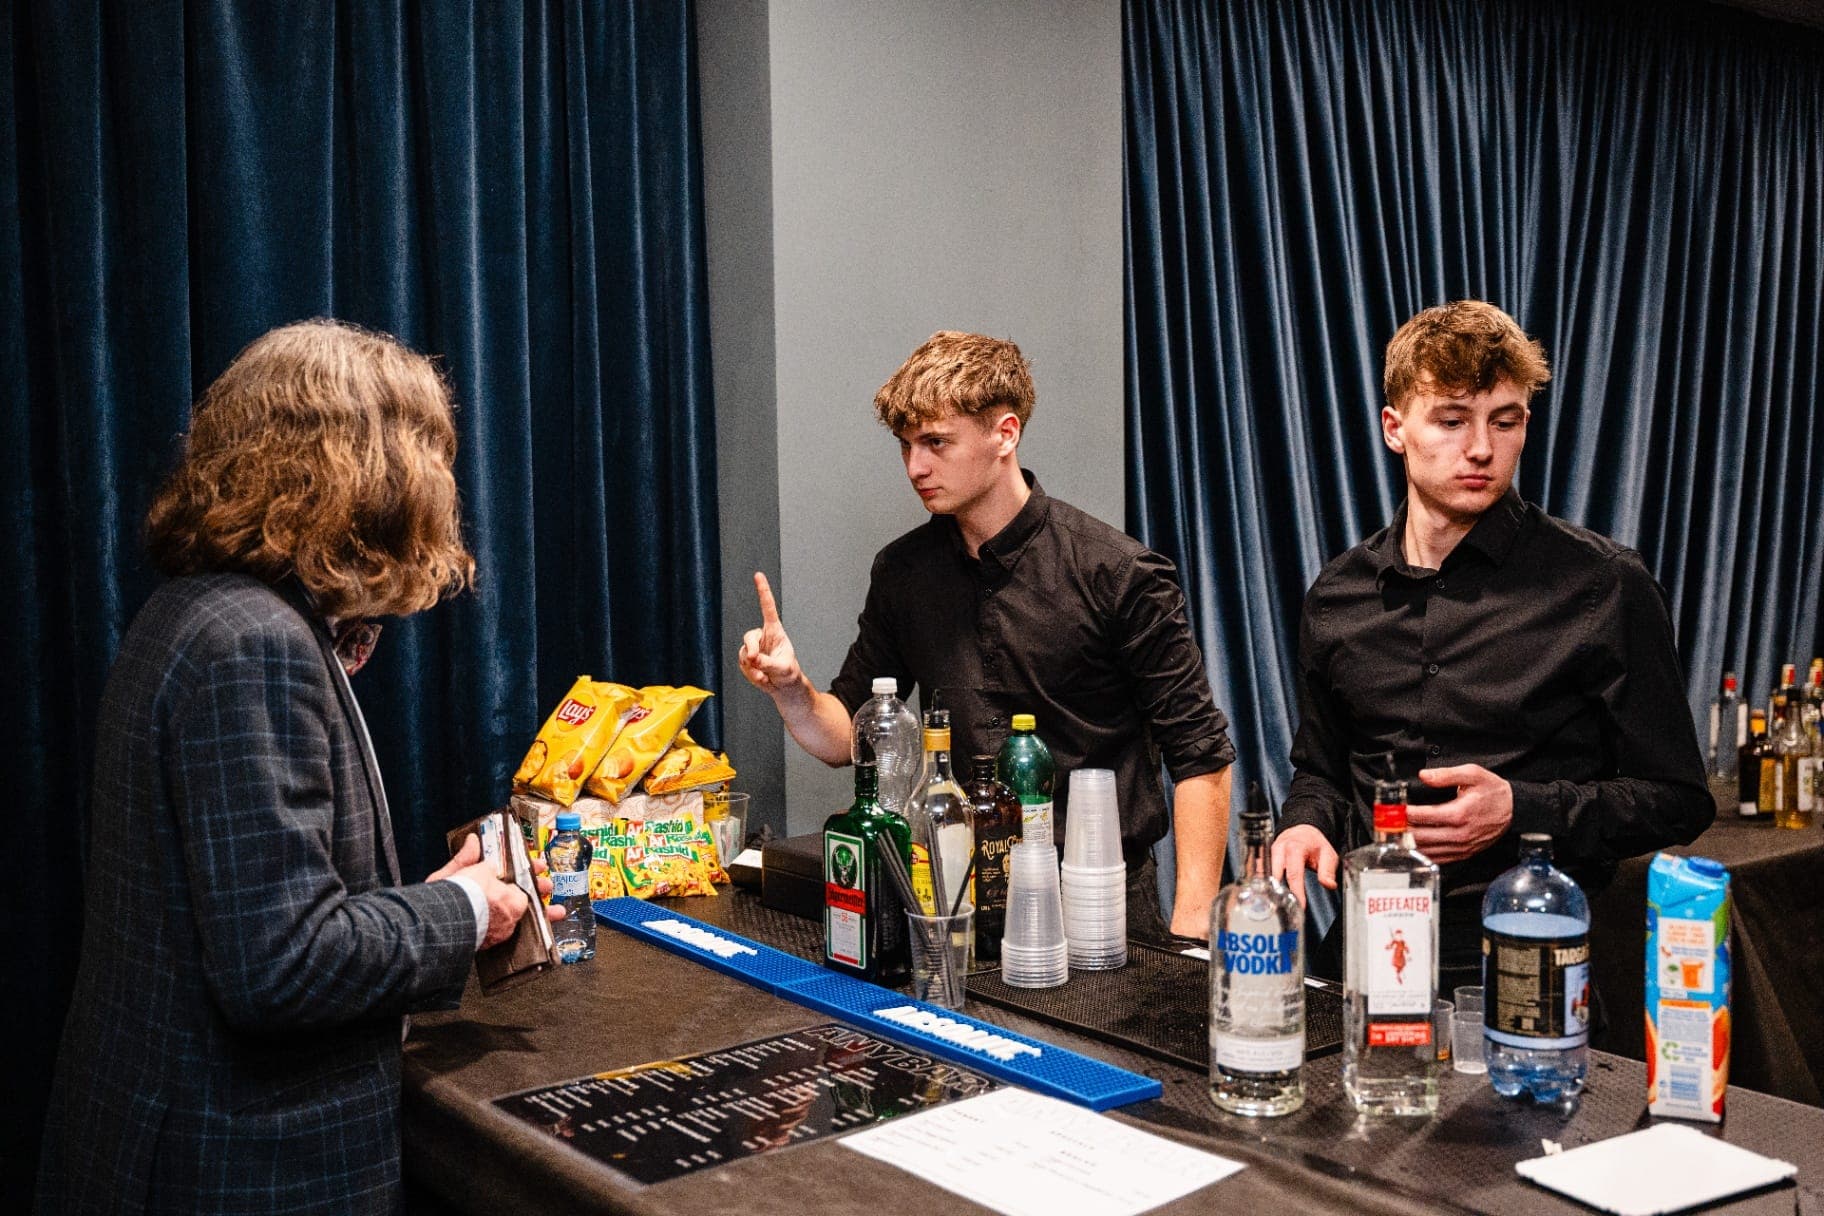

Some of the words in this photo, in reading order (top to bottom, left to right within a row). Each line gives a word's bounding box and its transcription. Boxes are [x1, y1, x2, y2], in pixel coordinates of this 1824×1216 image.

[600, 834, 636, 848] Rashi
[1368, 896, 1430, 915] BEEFEATER
[1224, 951, 1292, 975] VODKA
